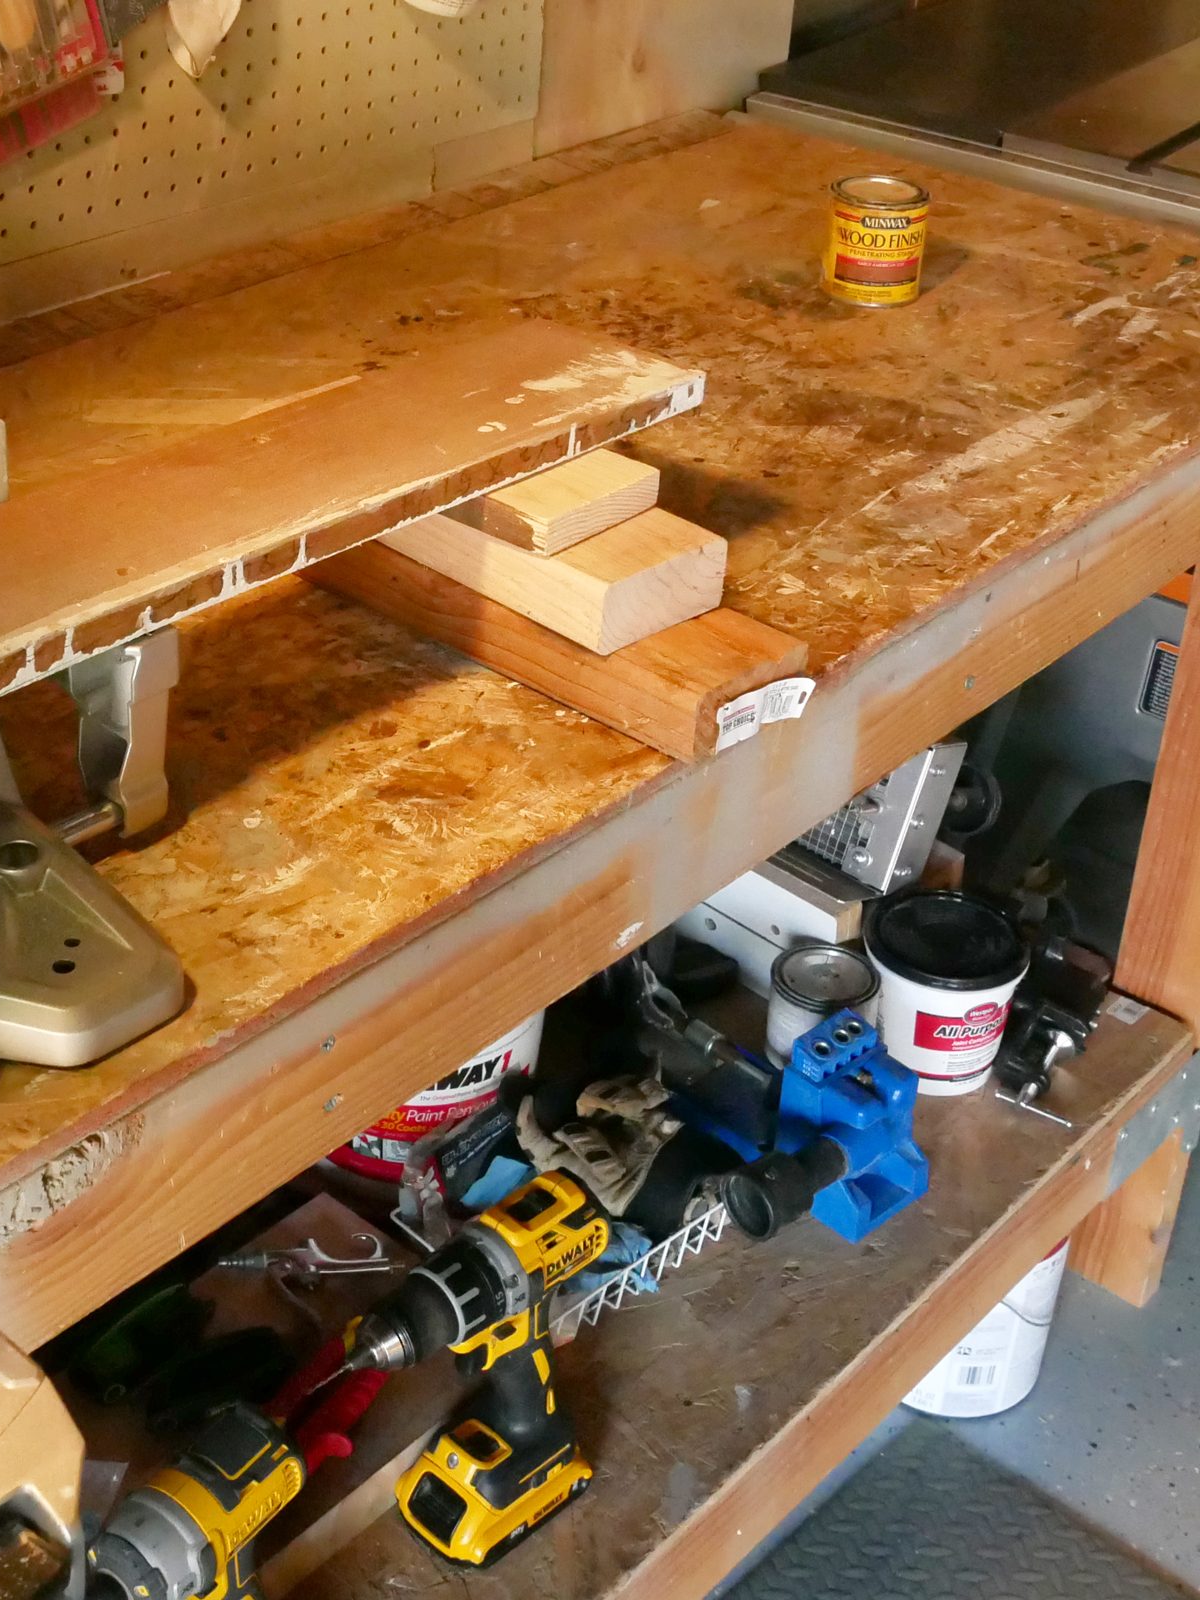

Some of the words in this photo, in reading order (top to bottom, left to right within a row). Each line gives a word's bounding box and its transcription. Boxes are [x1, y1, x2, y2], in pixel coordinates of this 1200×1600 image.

[864, 217, 907, 229] MINWAX
[840, 229, 886, 248] WOOD
[889, 230, 923, 248] FINISH
[850, 249, 895, 258] PENETRATING
[934, 1026, 959, 1038] All
[425, 1054, 502, 1091] WAY
[500, 1048, 513, 1073] 1
[406, 1108, 446, 1123] Paint
[547, 1234, 595, 1275] DEWALT
[495, 1291, 505, 1306] 15
